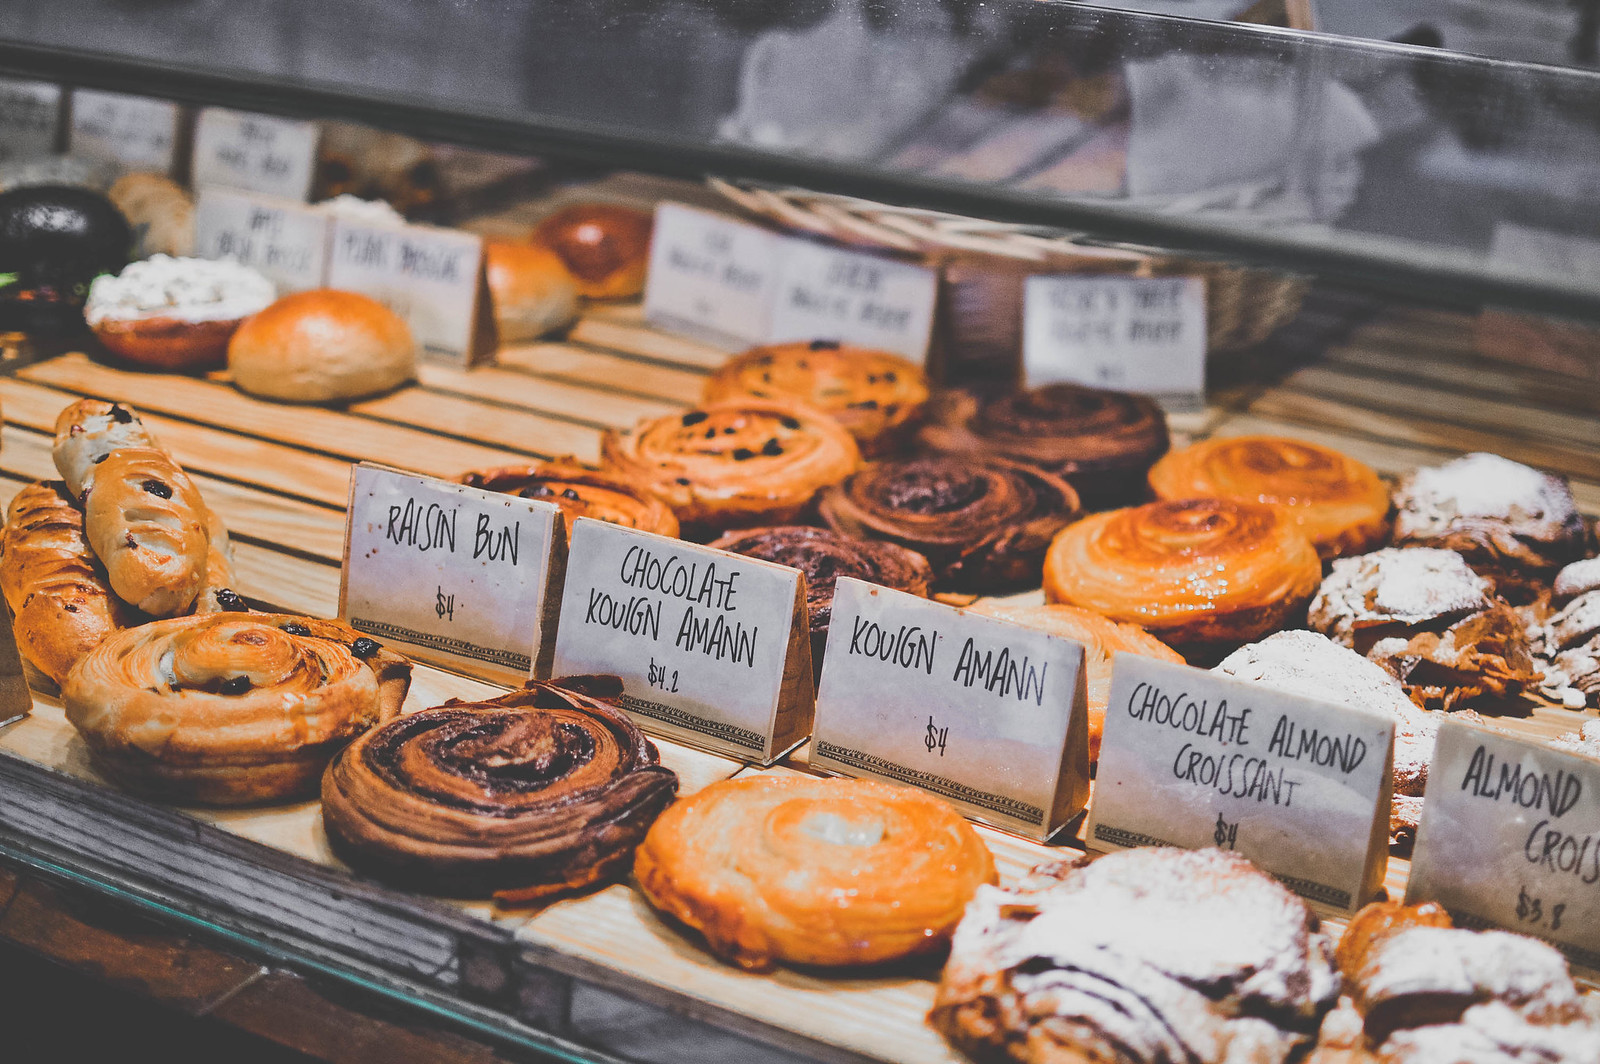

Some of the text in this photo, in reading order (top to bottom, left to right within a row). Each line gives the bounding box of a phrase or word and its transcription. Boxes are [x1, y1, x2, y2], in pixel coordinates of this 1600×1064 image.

[387, 497, 521, 566] RAISIN BUN
[435, 586, 456, 622] $4
[621, 546, 741, 611] CHOCOLATE
[585, 587, 759, 668] KOUIGN AMANN
[647, 657, 680, 693] $4.2
[849, 615, 1048, 706] KOUIGN AMANN
[924, 715, 949, 757] $4
[1128, 682, 1367, 775] CHOCOLATE ALMOND
[1173, 743, 1302, 808] CROISSANT
[1461, 745, 1582, 819] ALMOND
[1214, 812, 1239, 851] $4
